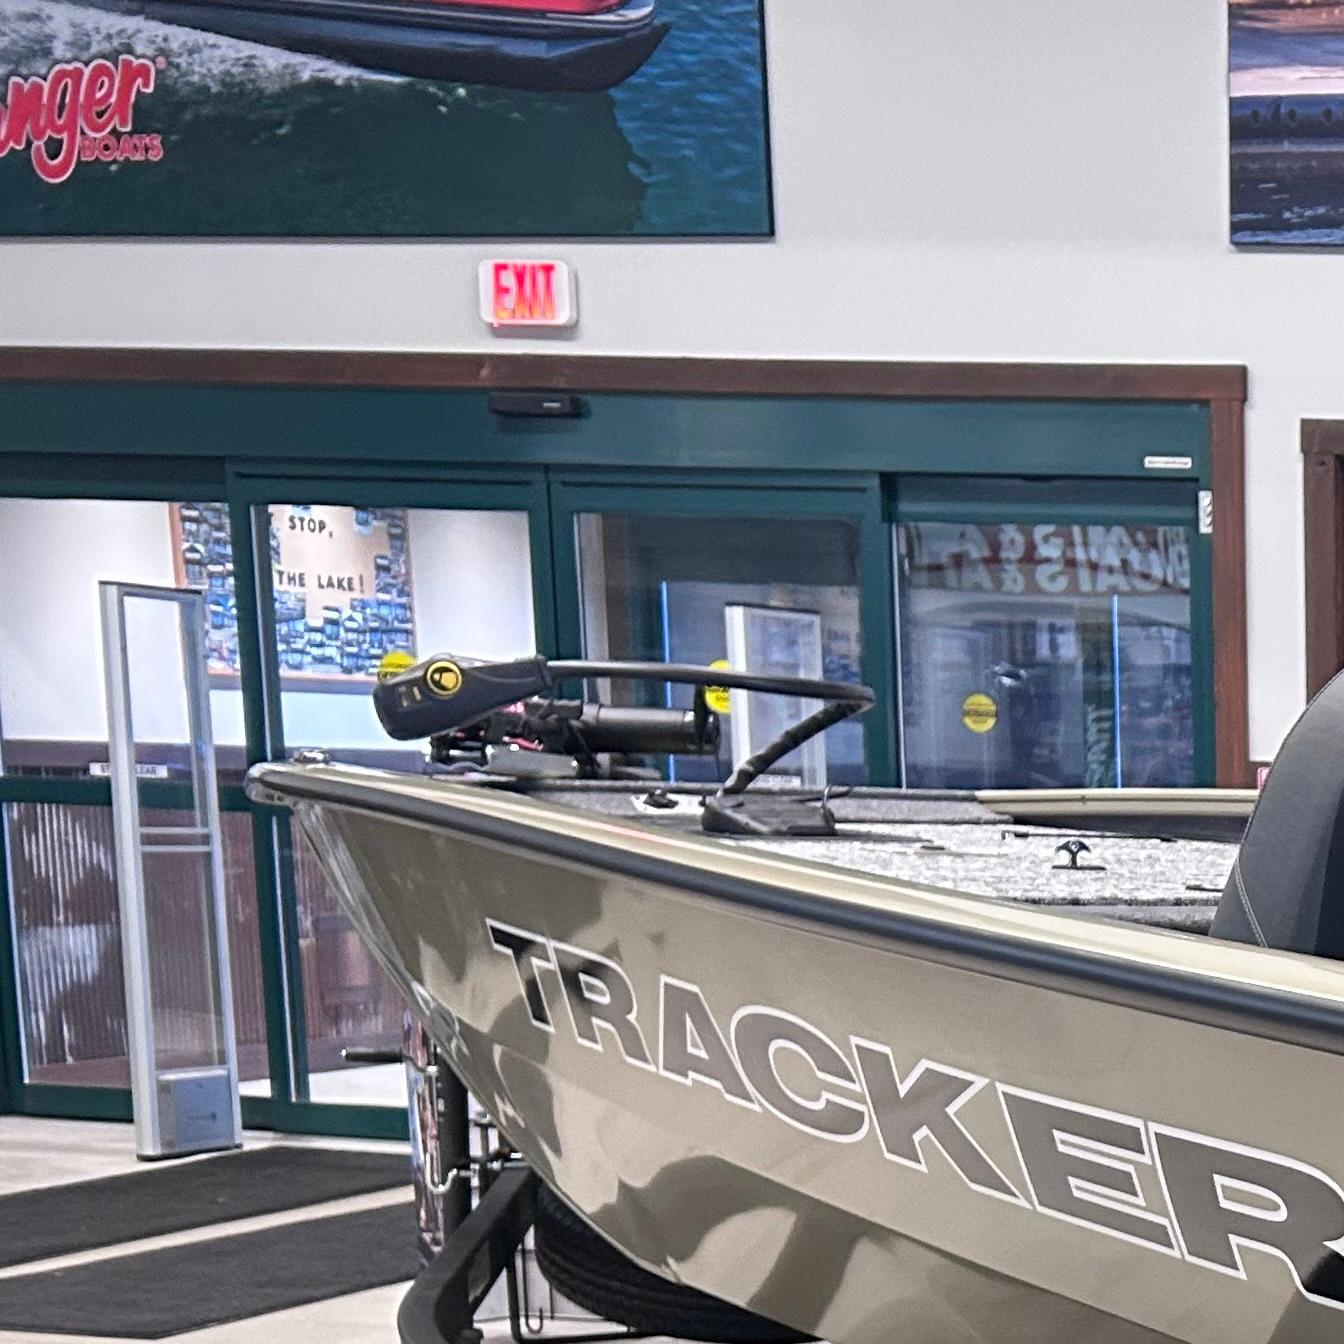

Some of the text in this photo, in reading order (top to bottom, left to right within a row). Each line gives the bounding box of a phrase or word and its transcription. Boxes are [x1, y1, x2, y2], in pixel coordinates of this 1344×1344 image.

[0, 54, 156, 184] nger
[79, 134, 164, 162] BOATS
[493, 263, 556, 321] EXIT
[288, 514, 334, 538] STOP,
[275, 569, 365, 594] THE LAKE!
